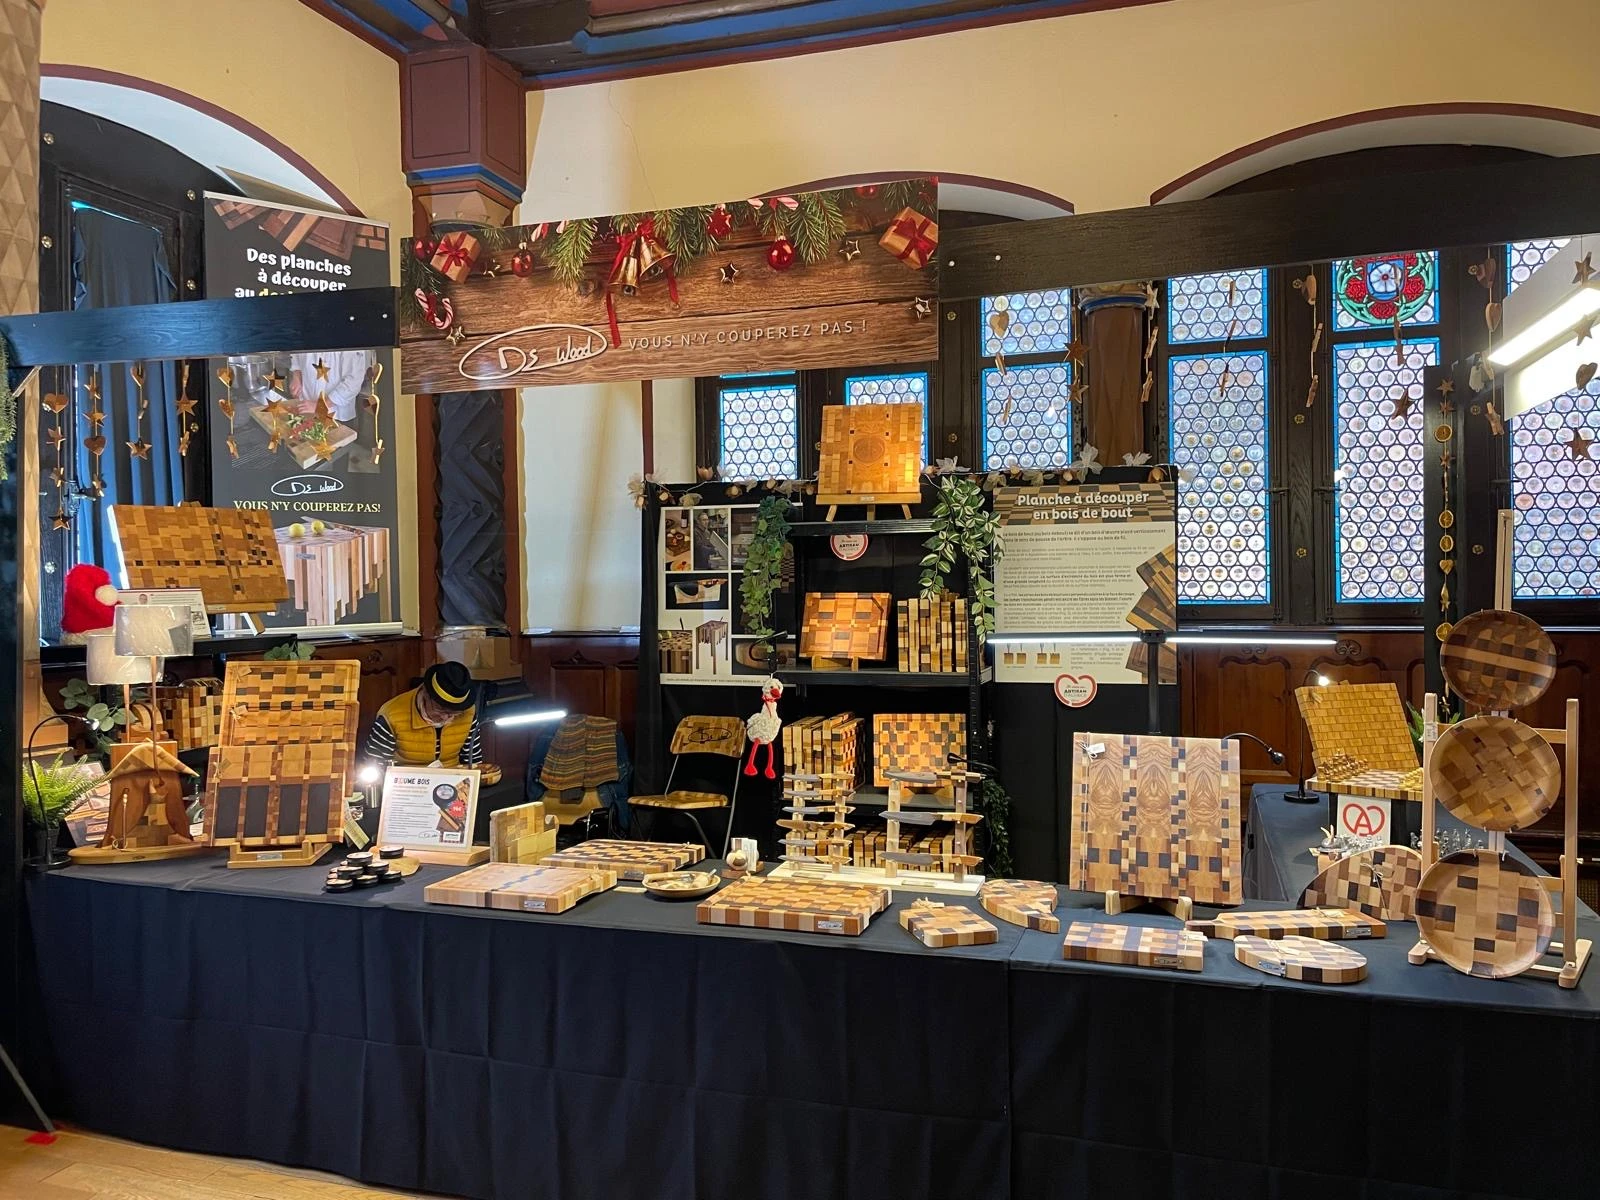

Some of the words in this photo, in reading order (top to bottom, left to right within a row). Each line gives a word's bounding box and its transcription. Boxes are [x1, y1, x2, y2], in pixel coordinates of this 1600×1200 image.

[246, 248, 277, 266] Des
[280, 254, 352, 276] planches
[257, 268, 268, 283] à
[271, 271, 347, 292] découper
[234, 288, 255, 298] au
[628, 335, 672, 350] VOUS
[681, 332, 708, 346] N'Y
[716, 324, 812, 343] COUPEREZ
[820, 320, 854, 335] PAS
[862, 320, 867, 332] !
[1018, 494, 1070, 506] Planche
[1072, 493, 1082, 504] à
[1086, 492, 1149, 506] découper
[233, 500, 268, 510] VOUS
[270, 502, 290, 511] N'Y
[294, 502, 354, 512] COUPEREZ
[356, 503, 381, 513] PAS!
[1033, 510, 1050, 520] en
[1052, 508, 1078, 520] bois
[1082, 508, 1098, 518] de
[1101, 506, 1133, 519] bout
